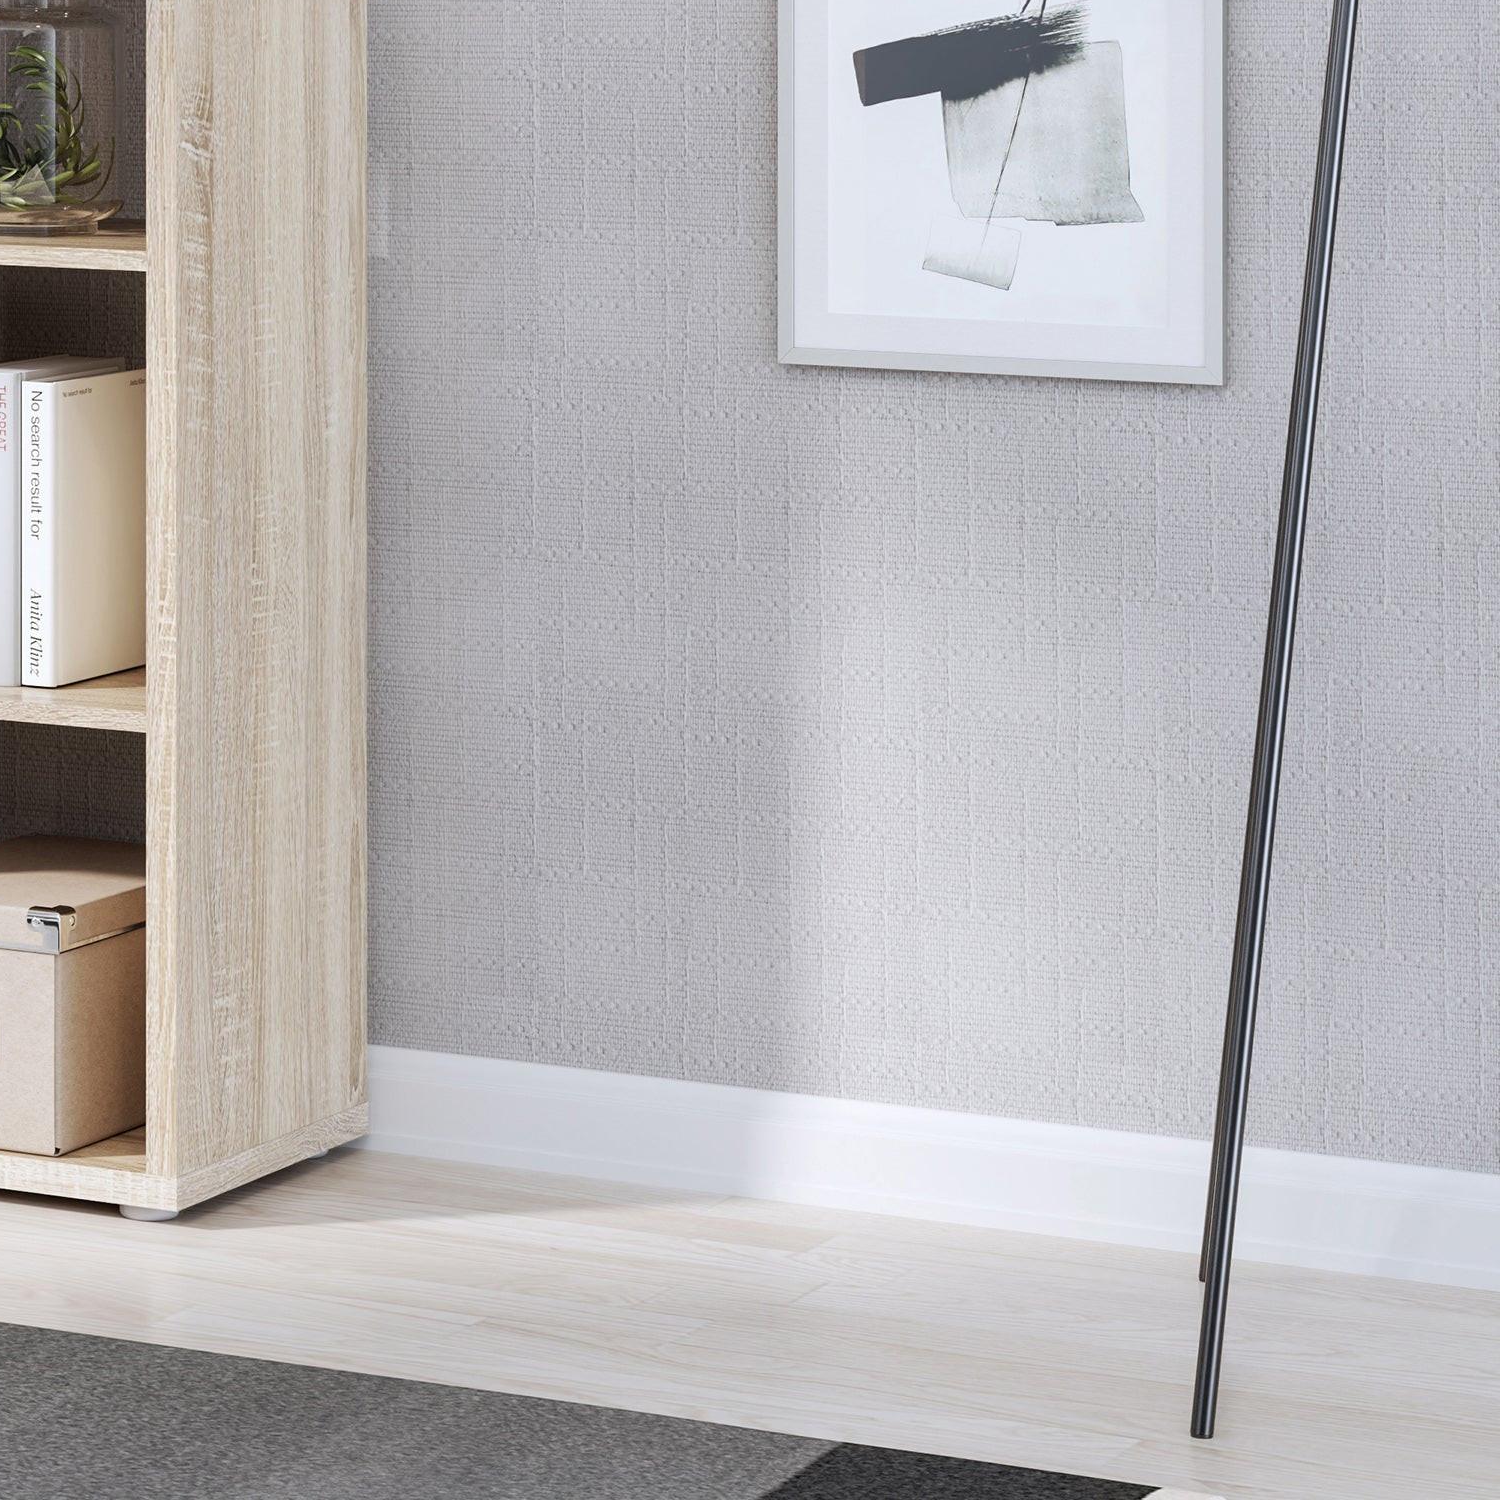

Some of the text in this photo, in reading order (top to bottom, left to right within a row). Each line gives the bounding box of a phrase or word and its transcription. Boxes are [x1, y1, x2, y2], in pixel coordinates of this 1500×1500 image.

[30, 390, 43, 541] No search result for
[29, 588, 42, 676] Anita Klinz
